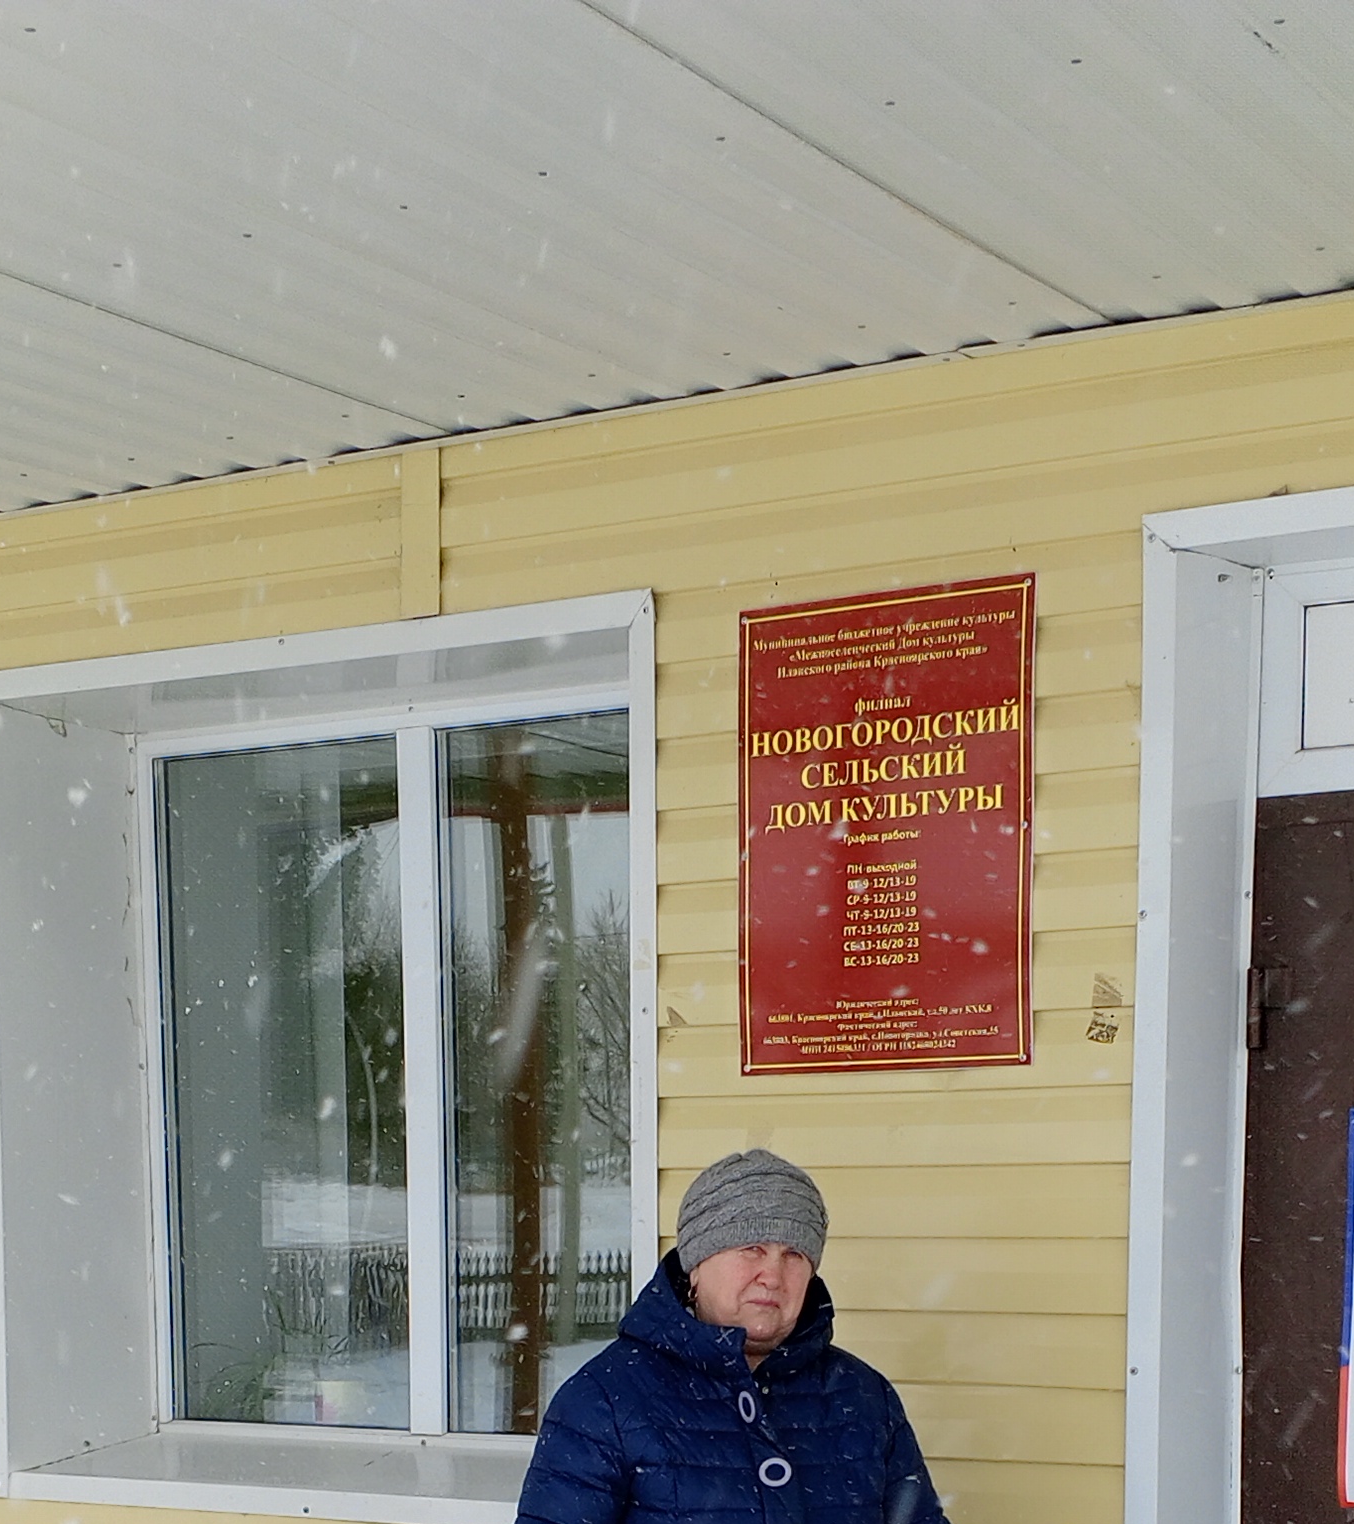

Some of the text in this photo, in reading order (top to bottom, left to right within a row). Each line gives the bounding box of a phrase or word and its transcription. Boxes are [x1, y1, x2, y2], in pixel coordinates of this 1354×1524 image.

[962, 610, 1016, 627] культуры
[897, 636, 920, 650] Дом
[923, 631, 975, 648] культуры
[834, 658, 871, 675] района
[873, 649, 953, 670] Красноярского
[854, 695, 912, 716] филиал
[750, 698, 1020, 758] НОВОГОРОДСКИЙ
[800, 743, 967, 789] СЕЛЬСКИЙ
[765, 783, 1004, 834] ДОМ КУЛЬТУРЫ
[843, 832, 880, 847] График
